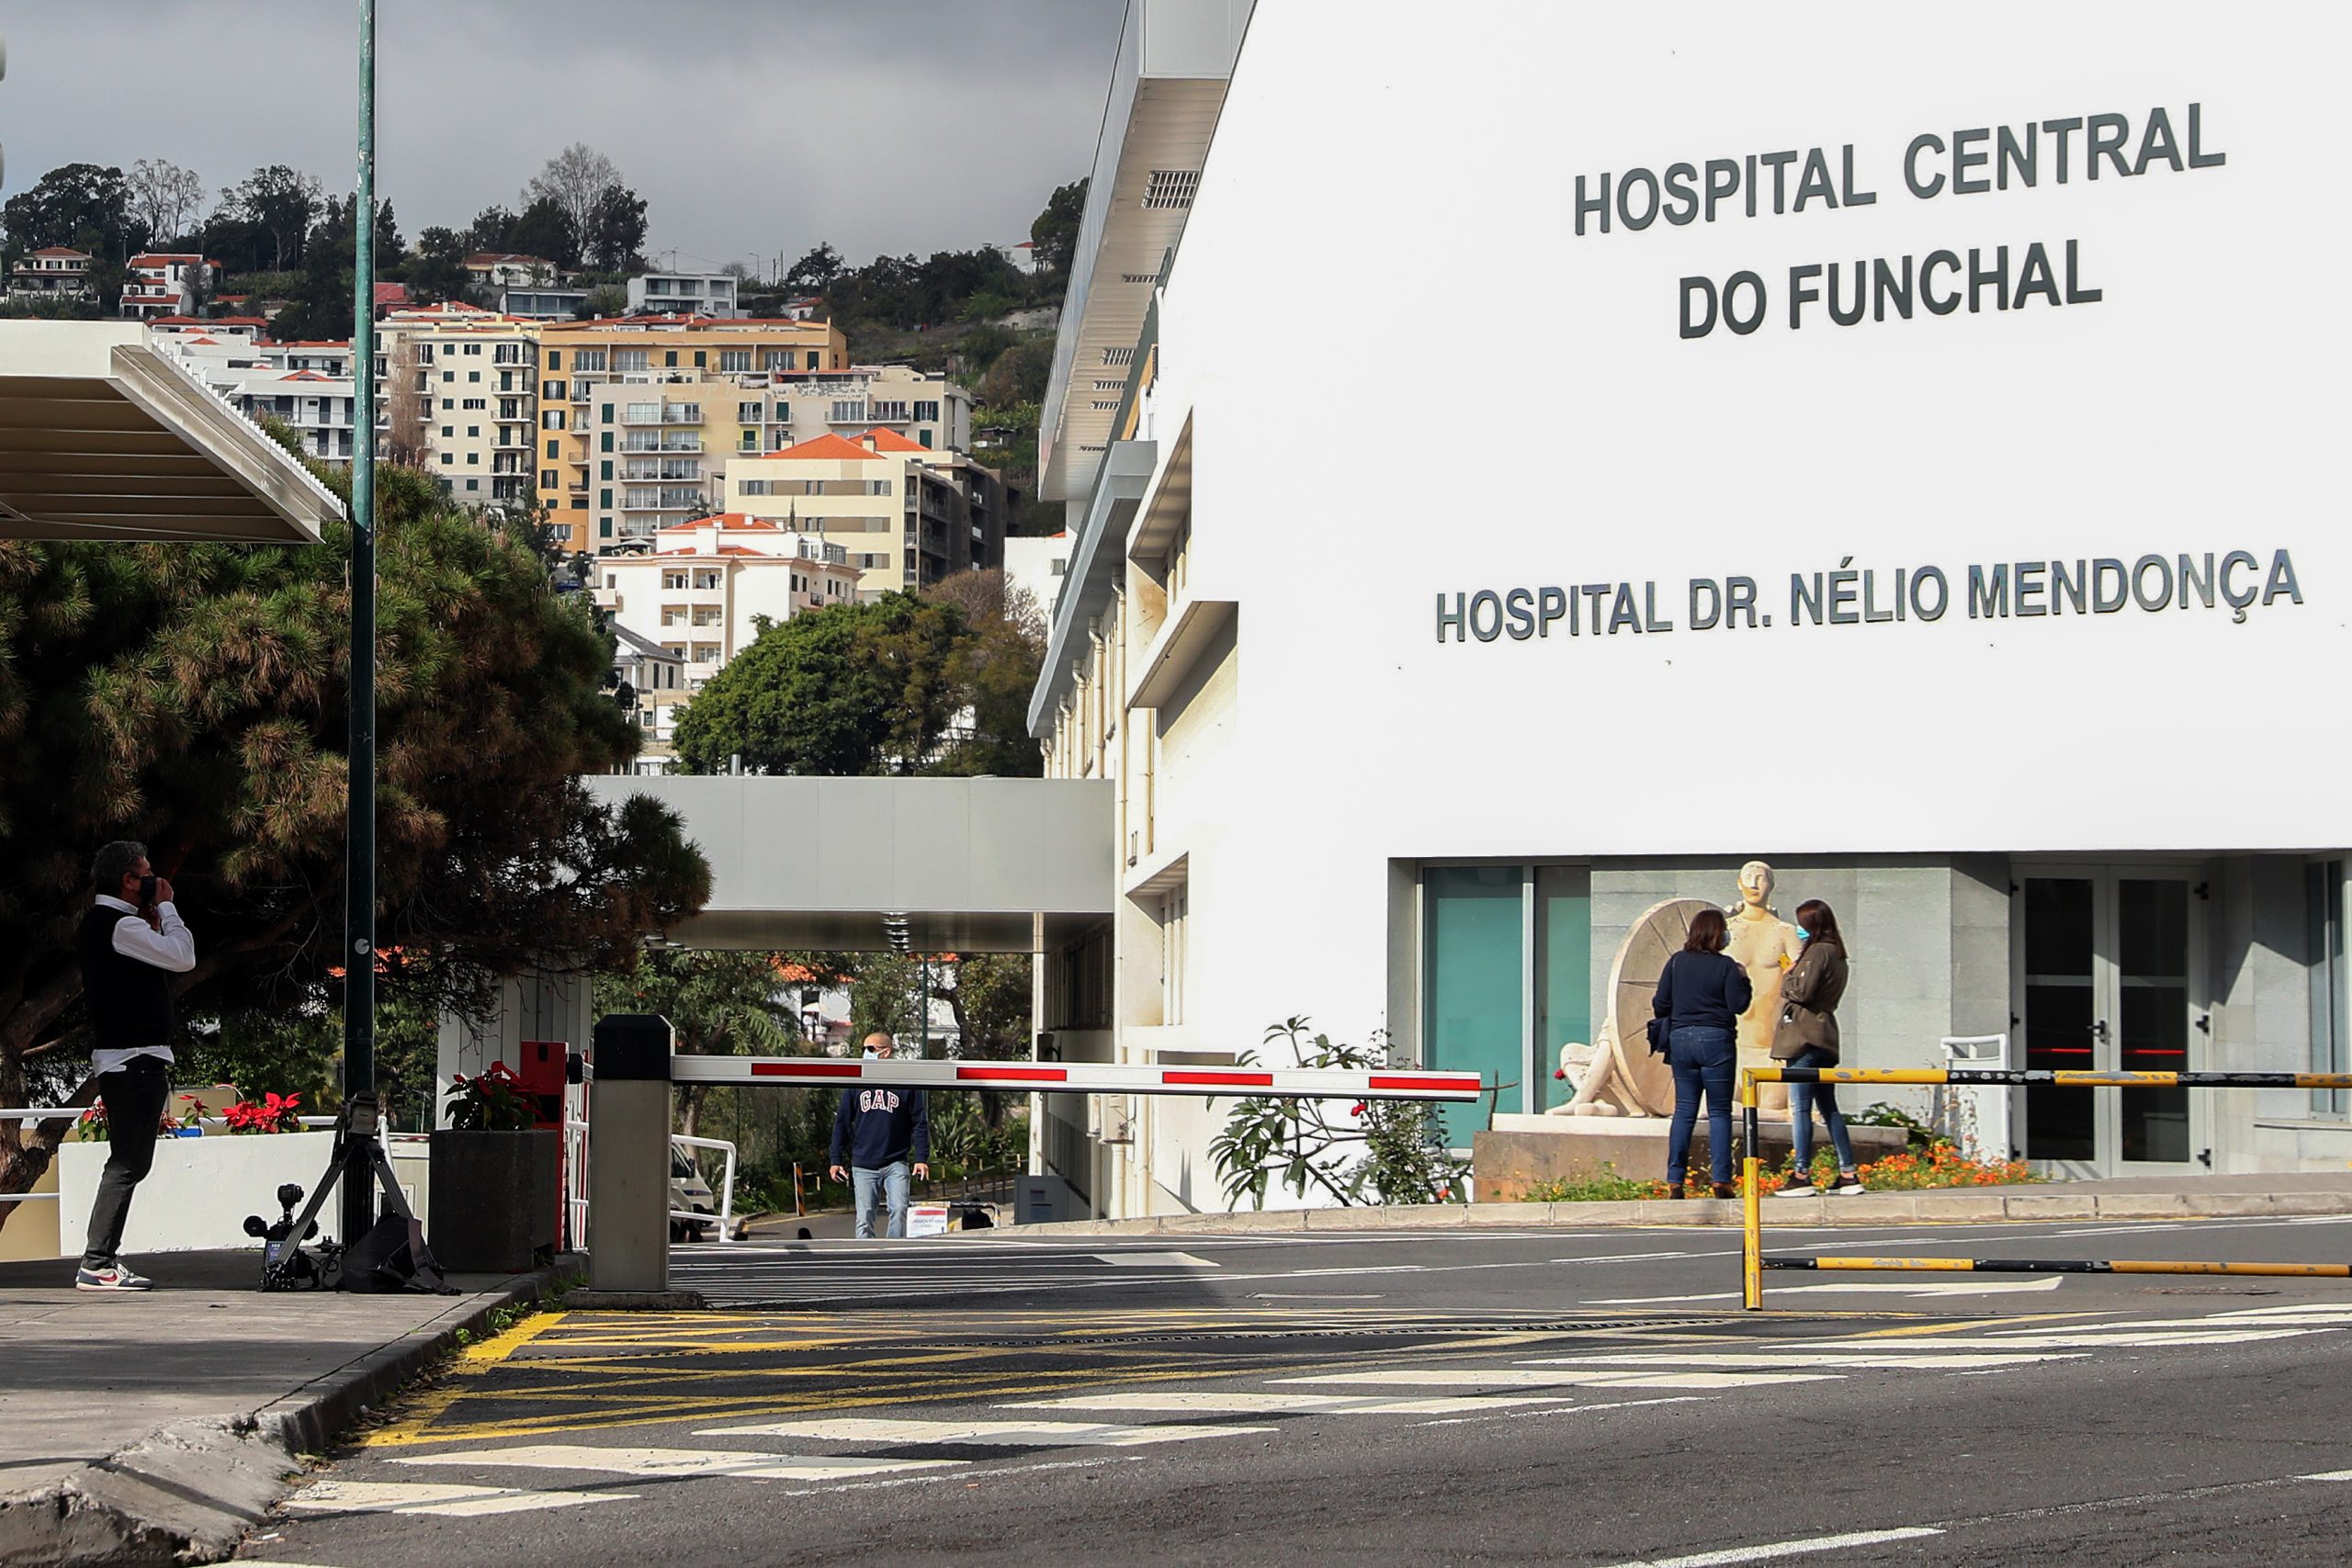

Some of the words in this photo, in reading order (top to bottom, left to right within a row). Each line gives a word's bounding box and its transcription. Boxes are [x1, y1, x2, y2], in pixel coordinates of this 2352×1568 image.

[1575, 143, 1877, 237] HOSPITAL
[1904, 102, 2226, 200] CENTRAL
[1679, 270, 1768, 340] DO
[1789, 238, 2103, 331] FUNCHAL
[1436, 581, 1674, 644] HOSPITAL
[1689, 575, 1772, 631] DR.
[1791, 556, 1949, 626] NÉLIO
[1968, 548, 2304, 625] MENDONÇA
[859, 1089, 899, 1113] GAP
